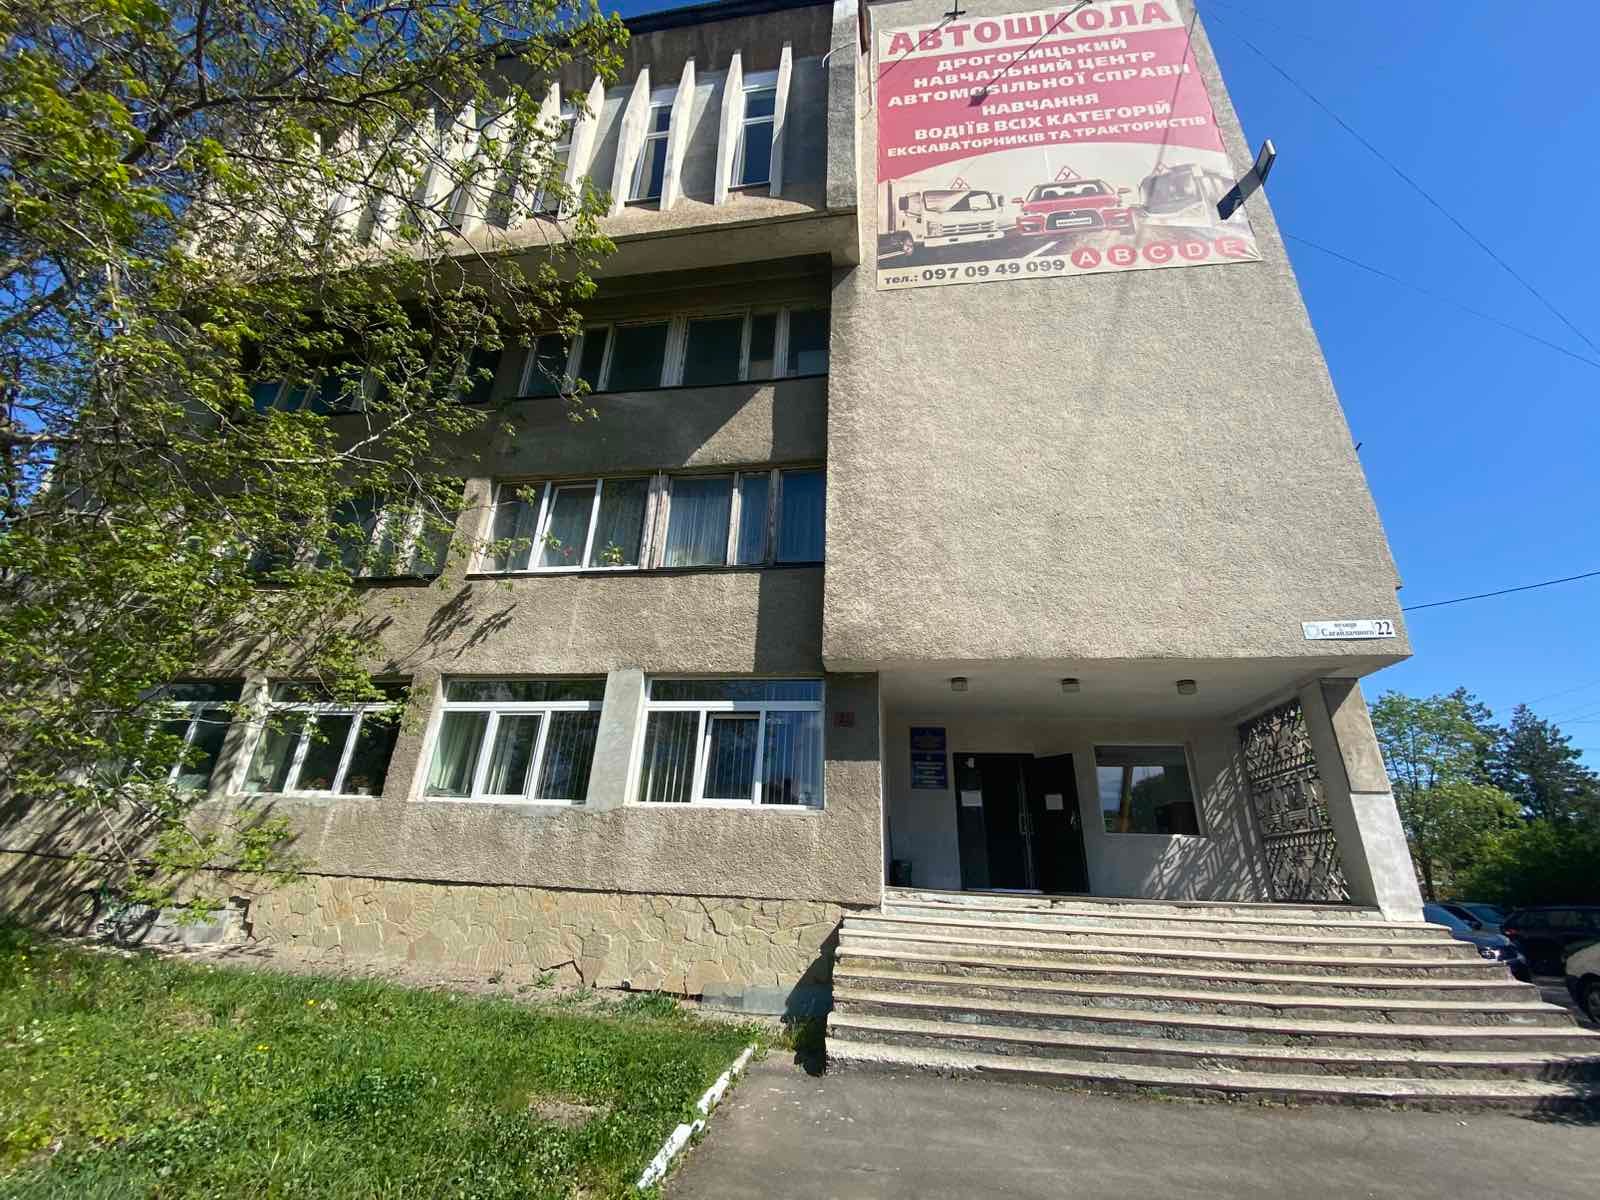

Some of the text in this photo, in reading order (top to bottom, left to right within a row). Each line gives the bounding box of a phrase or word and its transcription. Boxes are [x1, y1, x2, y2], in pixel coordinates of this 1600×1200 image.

[888, 2, 1172, 55] АВТОШКОЛА
[937, 38, 1127, 72] ДРОГОБИЦЬКИЙ
[914, 51, 1156, 88] НАВЧАЛЬНИЙ ЦЕНТР
[1092, 63, 1190, 82] СПРАВИ
[982, 93, 1099, 116] НАВЧАННЯ
[915, 100, 1171, 140] ВОДІЇВ ВСІХ КАТЕГОРІЙ
[888, 116, 1208, 157] ЕКСКАВАТОРНИКІВ ТА ТРАКТОРИСТІВ
[1079, 251, 1097, 265] A
[1115, 248, 1129, 263] B
[1150, 244, 1167, 259] C
[1187, 242, 1202, 256] D
[922, 267, 959, 281] 097
[965, 264, 989, 277] 09
[995, 262, 1020, 274] 49
[1026, 259, 1065, 273] 099
[1375, 621, 1392, 635] 22
